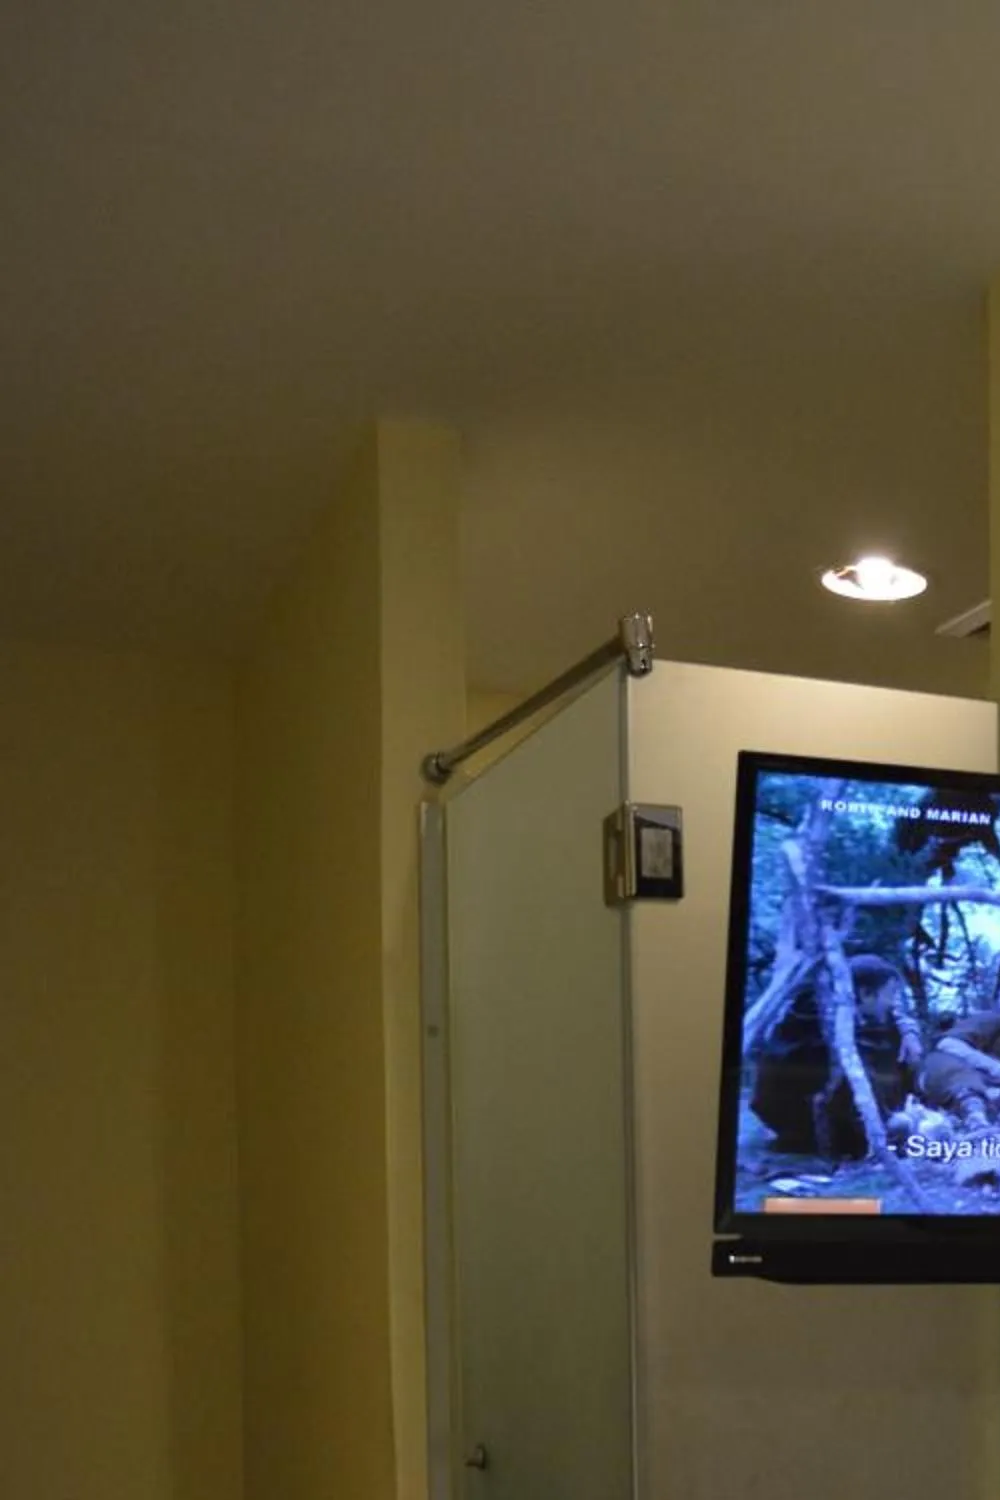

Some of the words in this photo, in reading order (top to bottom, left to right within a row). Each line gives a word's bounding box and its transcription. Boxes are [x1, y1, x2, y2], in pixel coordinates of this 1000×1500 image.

[886, 804, 921, 820] AND
[926, 807, 991, 825] MARIAN
[906, 1134, 973, 1164] Saya
